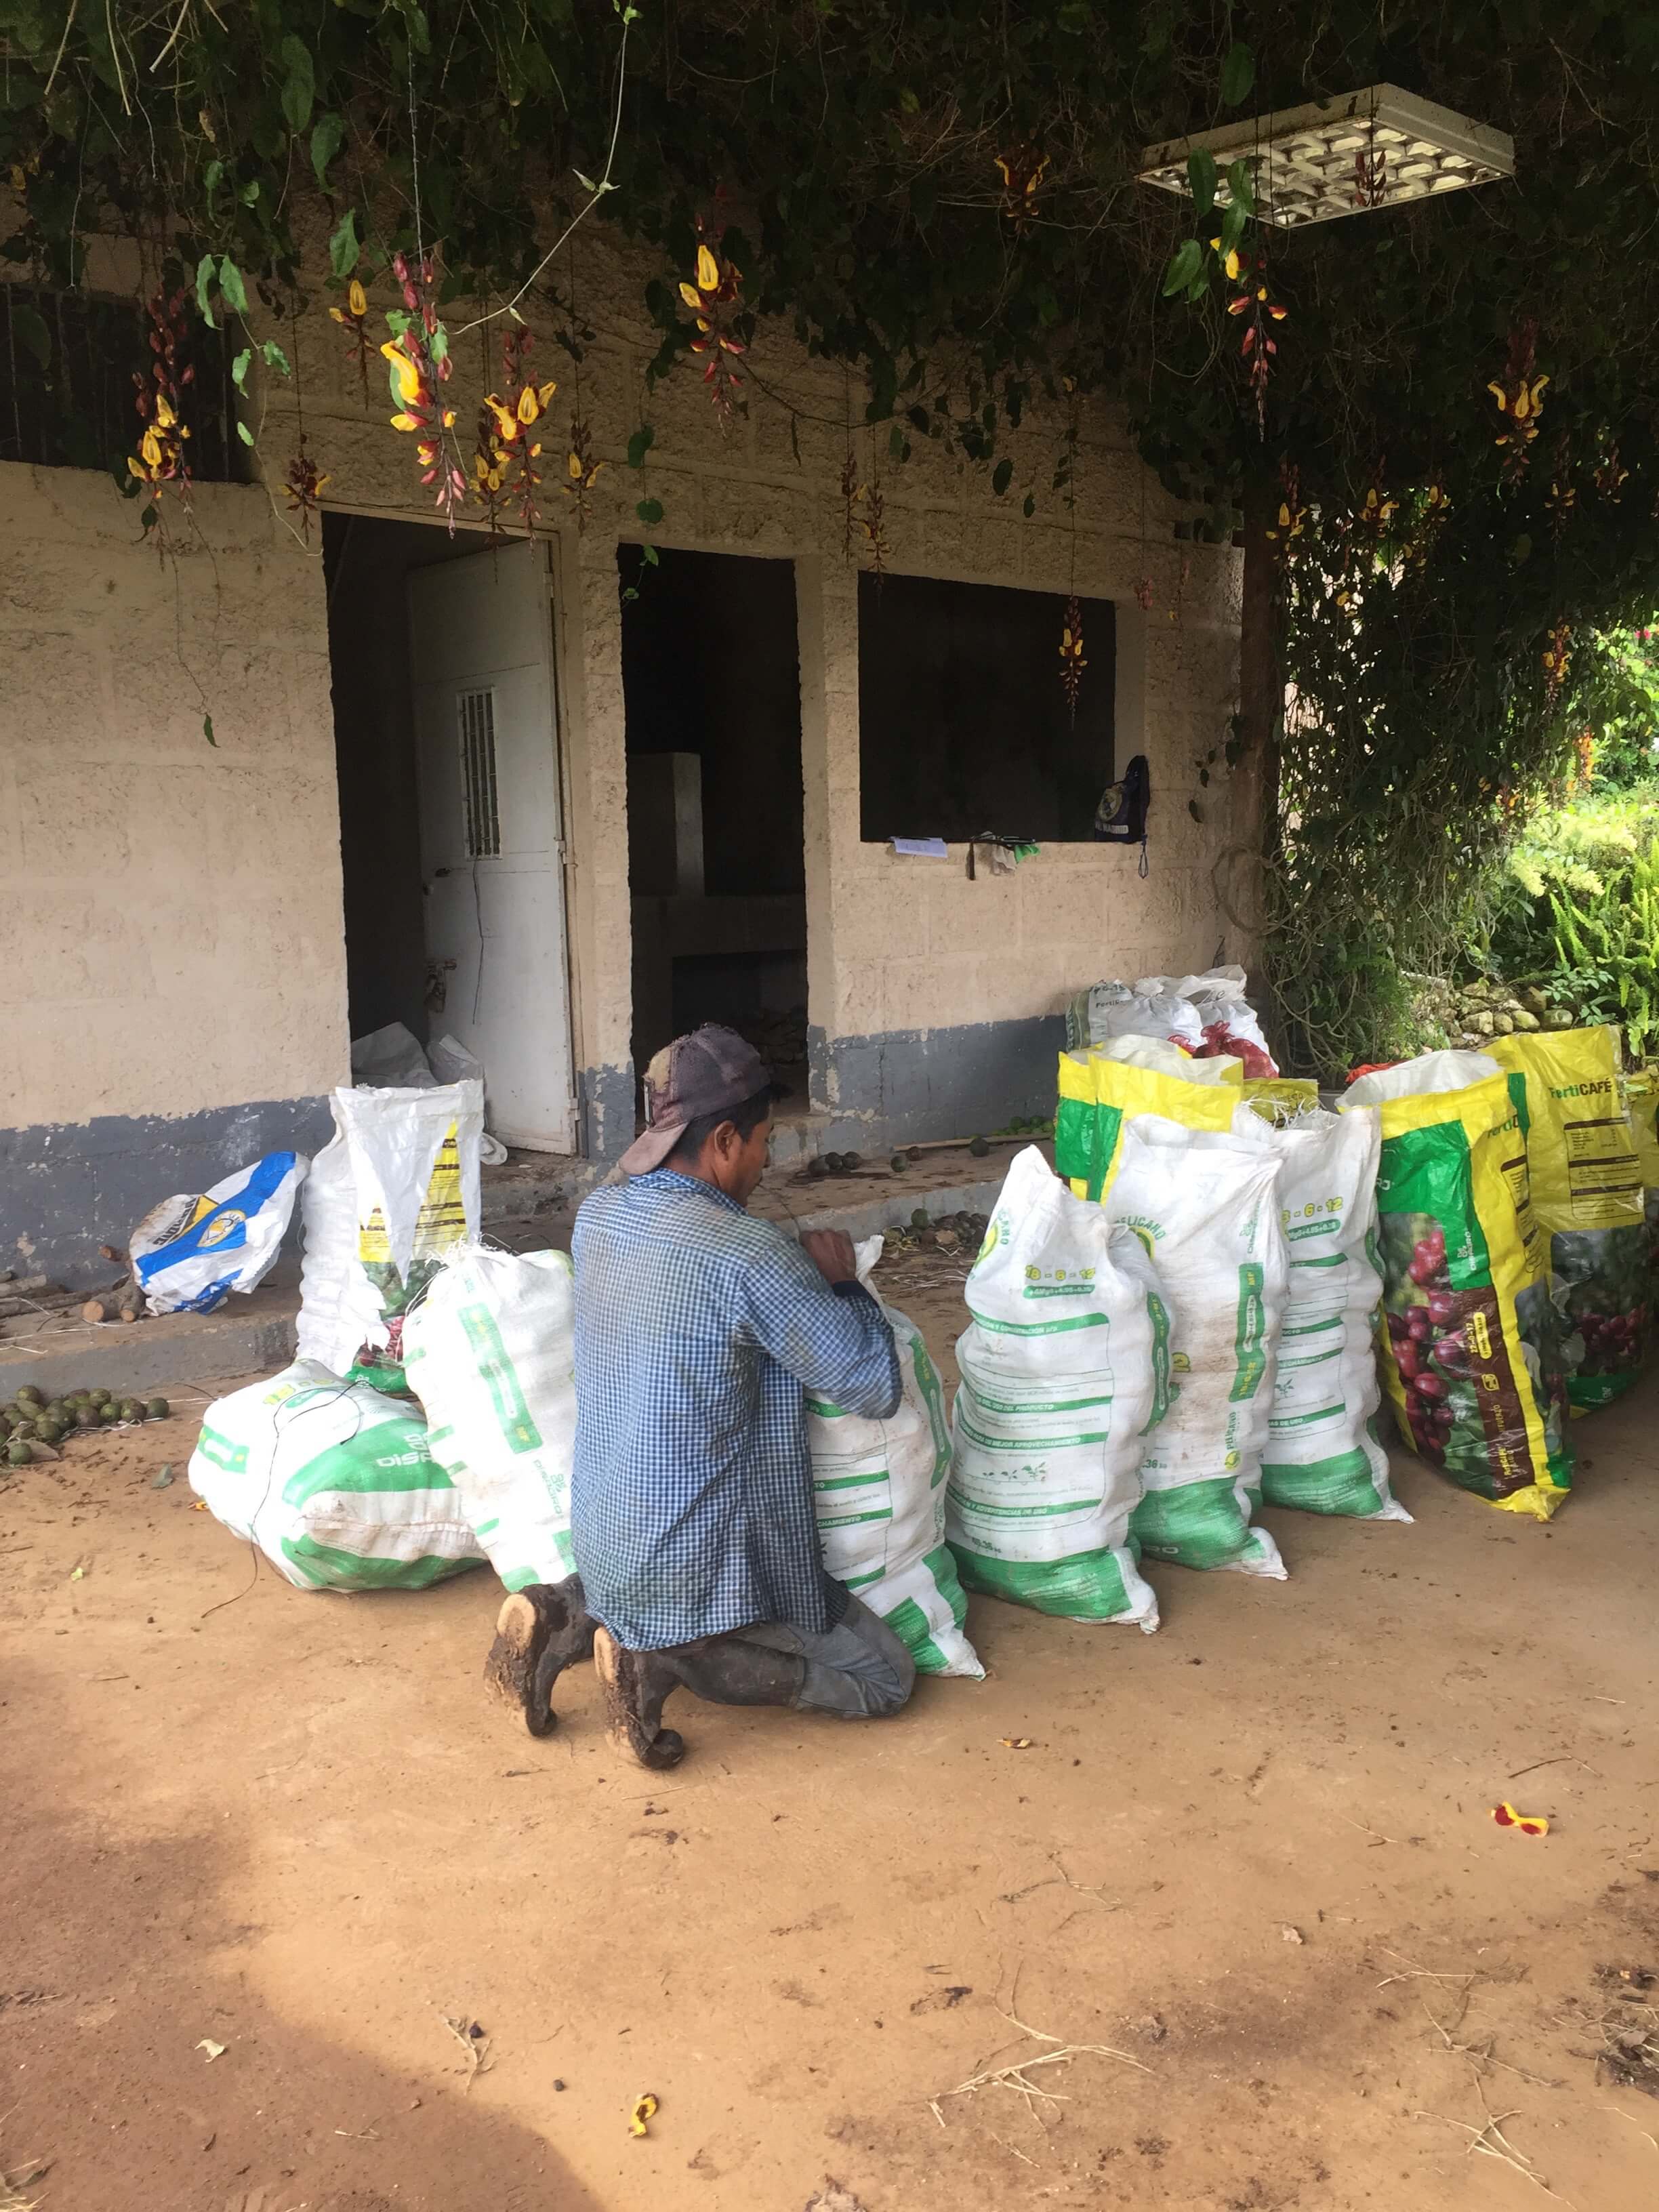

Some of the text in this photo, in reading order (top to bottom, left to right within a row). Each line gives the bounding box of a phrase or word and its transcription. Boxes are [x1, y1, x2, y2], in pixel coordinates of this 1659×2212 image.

[1550, 1078, 1612, 1099] FertiCAFÉ
[1325, 1196, 1344, 1213] 12
[992, 1439, 1014, 1448] MEJOR
[1014, 1437, 1081, 1448] APROVECHAMIENTO
